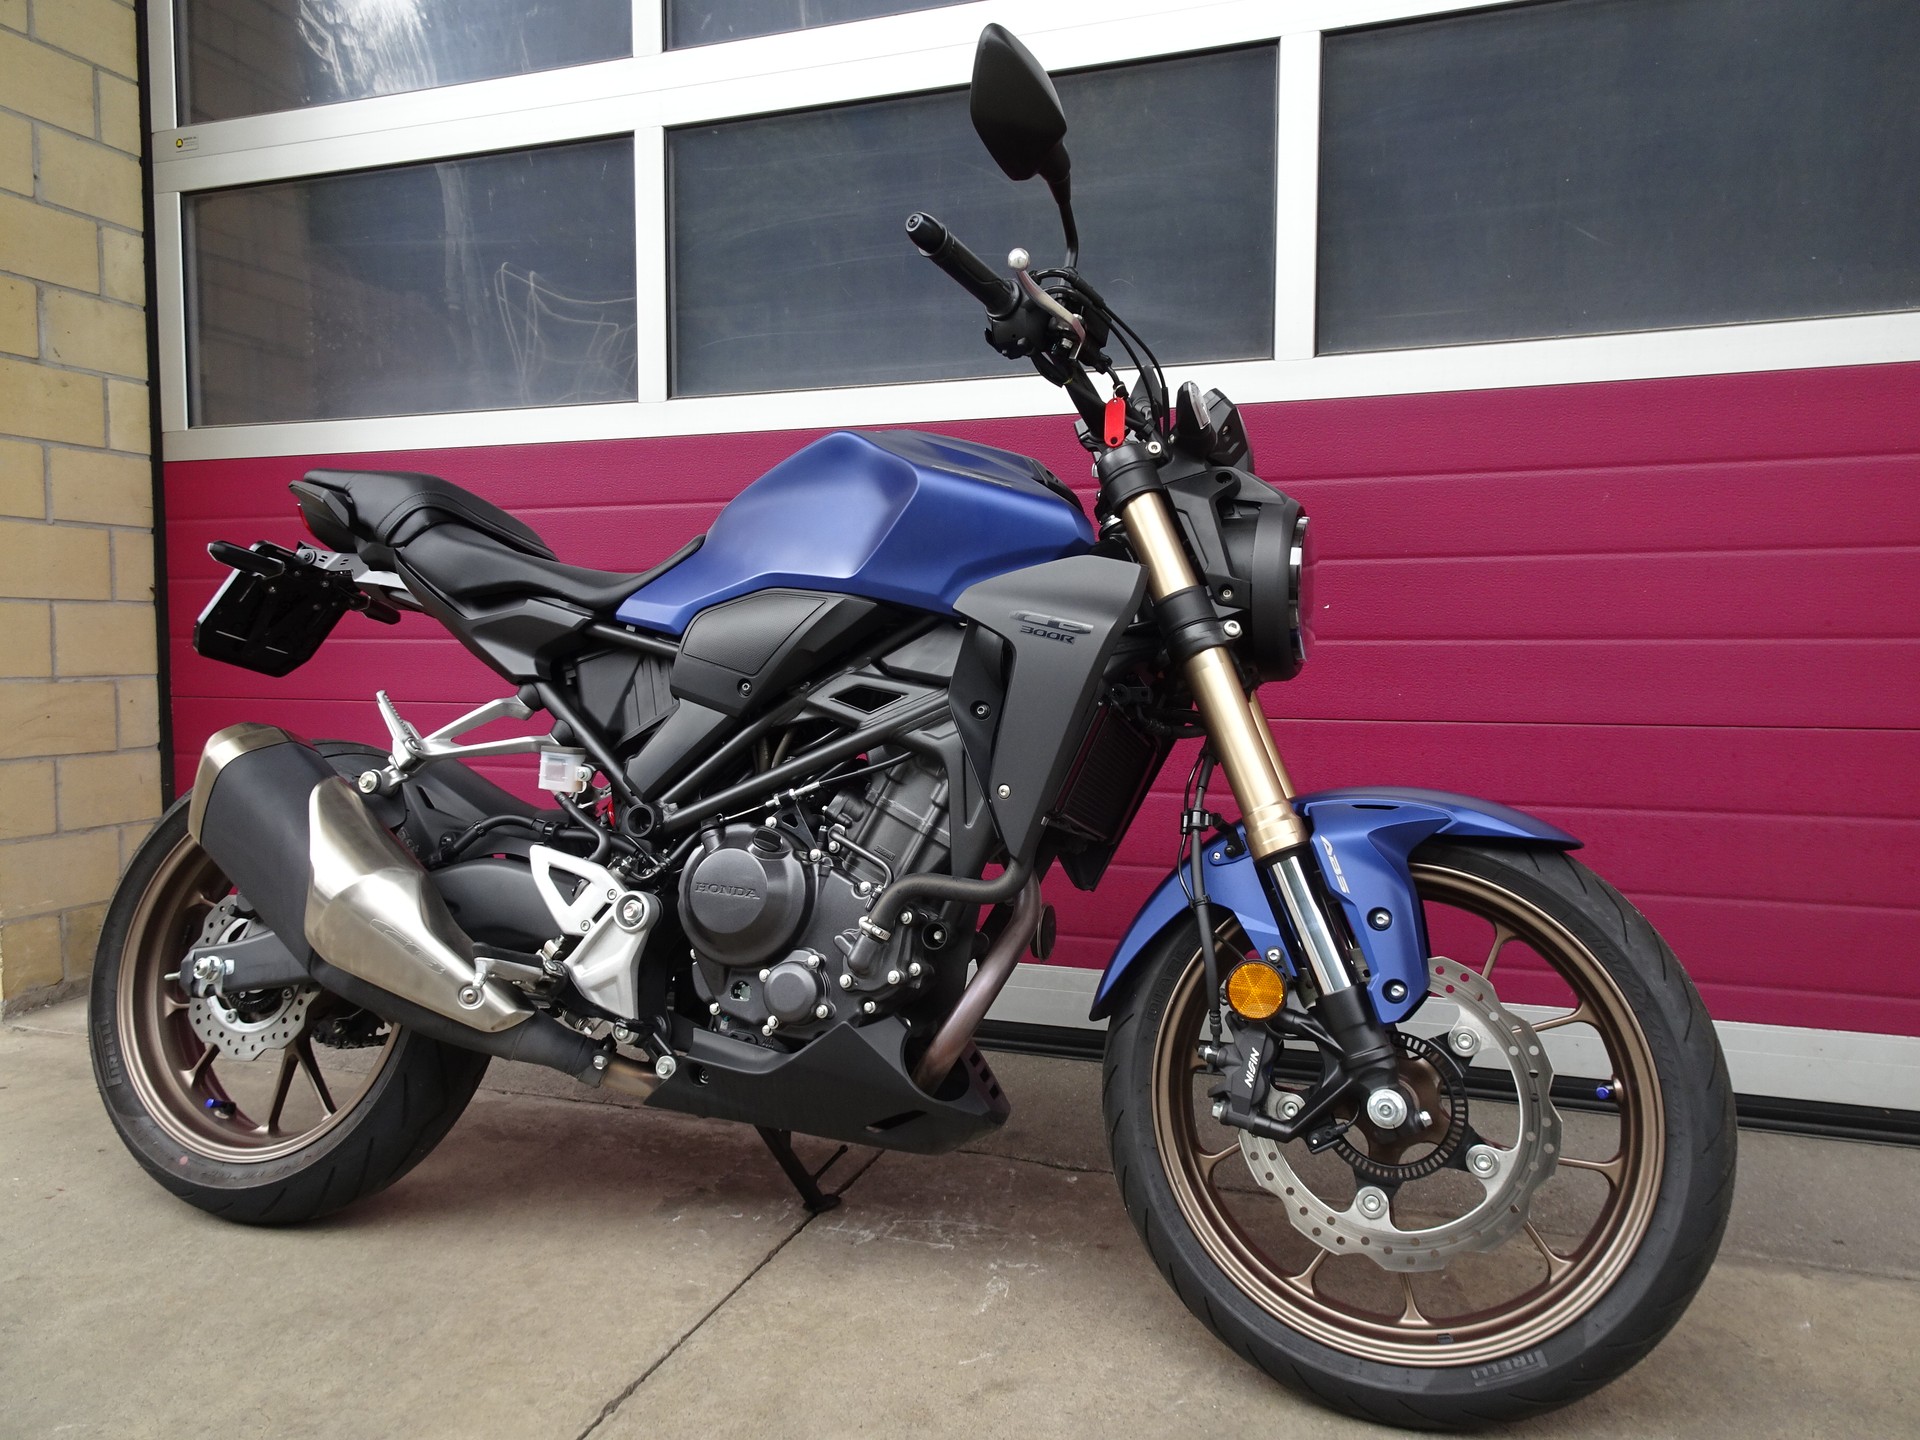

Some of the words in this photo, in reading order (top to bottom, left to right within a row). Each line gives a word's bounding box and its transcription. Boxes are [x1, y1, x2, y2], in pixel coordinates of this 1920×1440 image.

[1020, 625, 1076, 645] 300R
[1319, 834, 1351, 895] ABS
[694, 881, 761, 900] HONDA
[1470, 1349, 1548, 1387] PIRELLI
